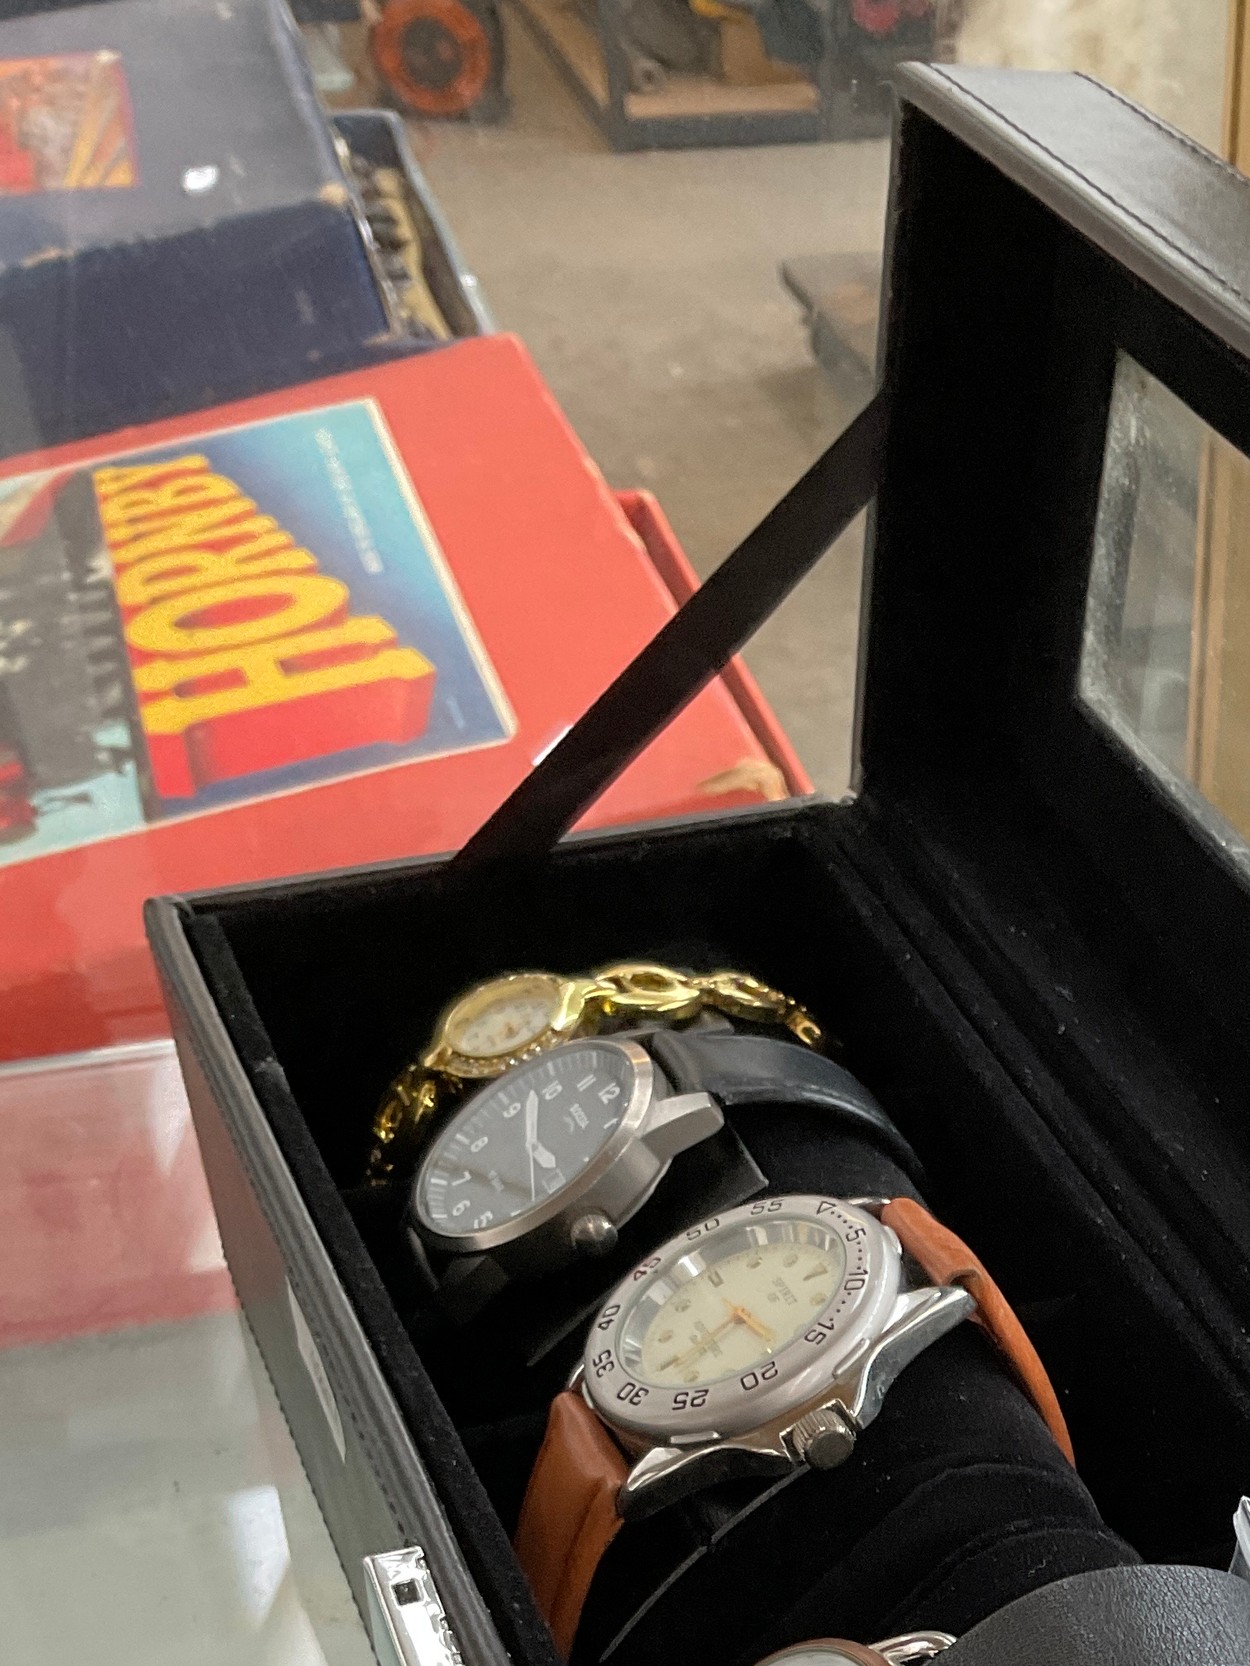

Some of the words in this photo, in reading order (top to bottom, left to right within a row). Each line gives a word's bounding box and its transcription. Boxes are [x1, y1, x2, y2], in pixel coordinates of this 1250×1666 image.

[93, 454, 437, 734] HORNBY
[599, 1082, 621, 1105] 12
[503, 1102, 521, 1119] 9
[452, 1199, 471, 1217] 6
[750, 1200, 784, 1216] 55
[687, 1218, 720, 1241] 50
[845, 1227, 866, 1244] 5
[633, 1256, 662, 1282] 45
[843, 1268, 869, 1292] 10
[597, 1304, 621, 1331] 40
[804, 1317, 835, 1346] 15
[592, 1349, 615, 1378] 35
[740, 1361, 779, 1391] 20
[617, 1382, 650, 1406] 30
[672, 1389, 710, 1411] 25
